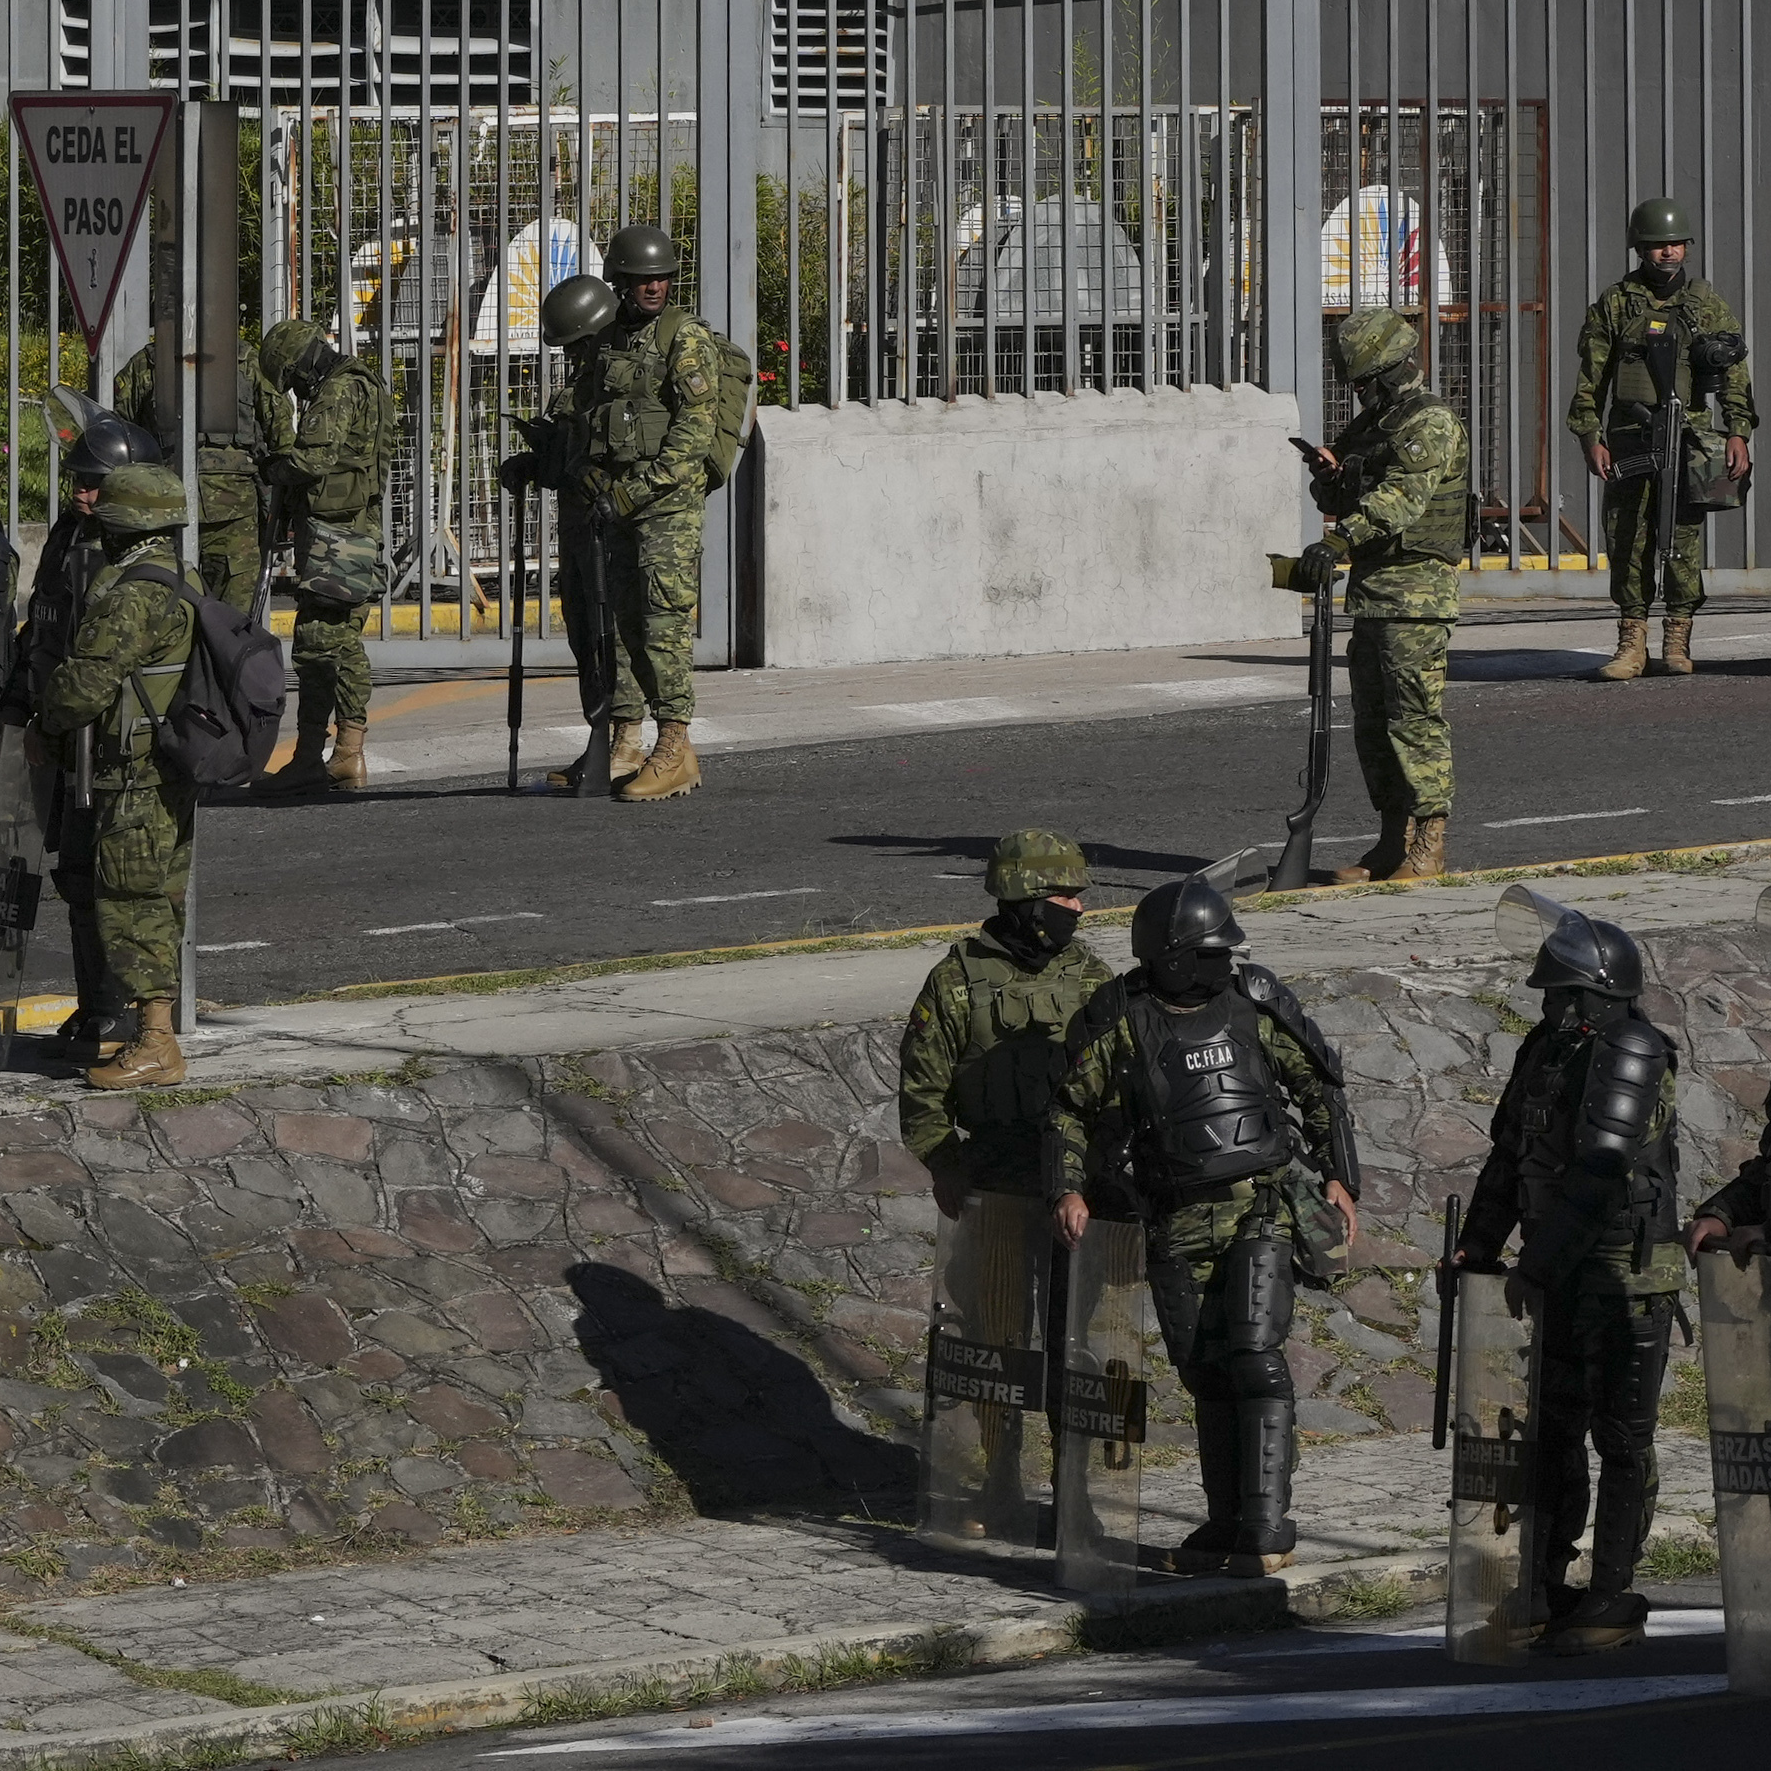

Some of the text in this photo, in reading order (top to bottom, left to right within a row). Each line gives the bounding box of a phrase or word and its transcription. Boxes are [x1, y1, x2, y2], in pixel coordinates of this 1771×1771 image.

[46, 126, 142, 164] CEDA EL
[64, 198, 123, 235] PASO
[1185, 1046, 1233, 1070] CC.FF.AA
[937, 1339, 1004, 1371] FUERZA
[1066, 1376, 1106, 1401] ERZA
